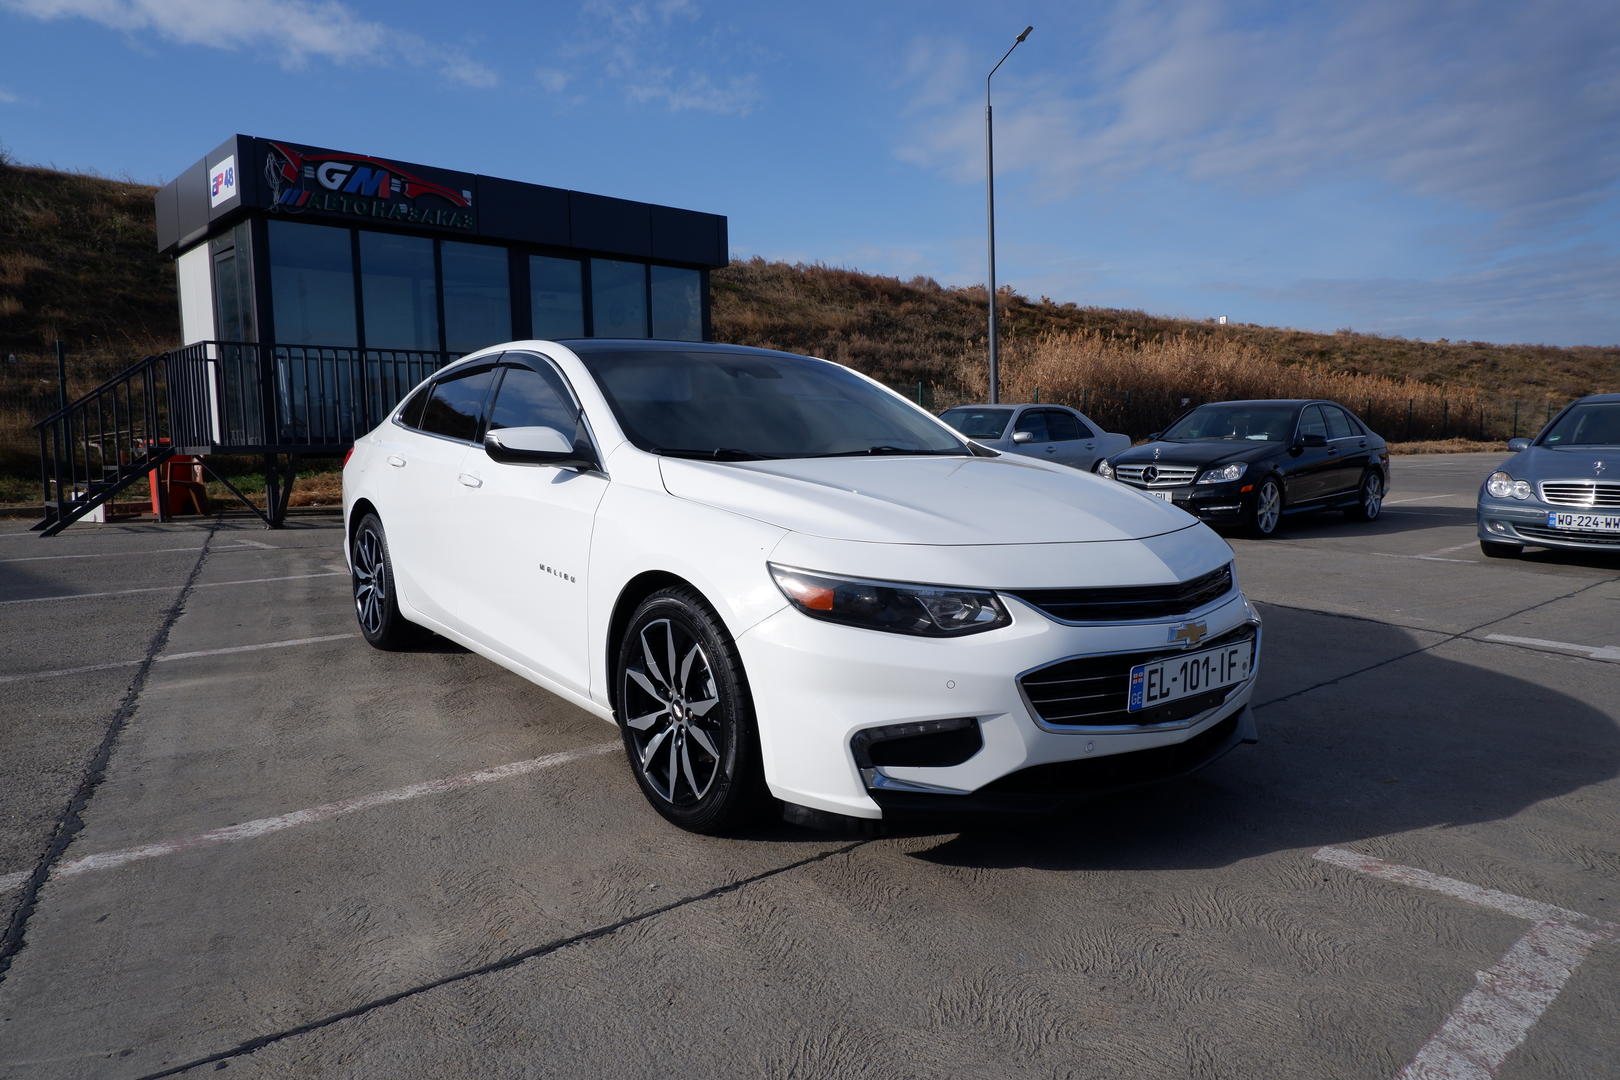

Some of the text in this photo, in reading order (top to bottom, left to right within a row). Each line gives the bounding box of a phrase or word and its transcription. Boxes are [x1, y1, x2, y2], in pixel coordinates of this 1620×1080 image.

[224, 167, 234, 188] 48
[317, 161, 391, 199] GM
[1146, 650, 1238, 702] EL-101-IF
[1131, 692, 1142, 706] GE
